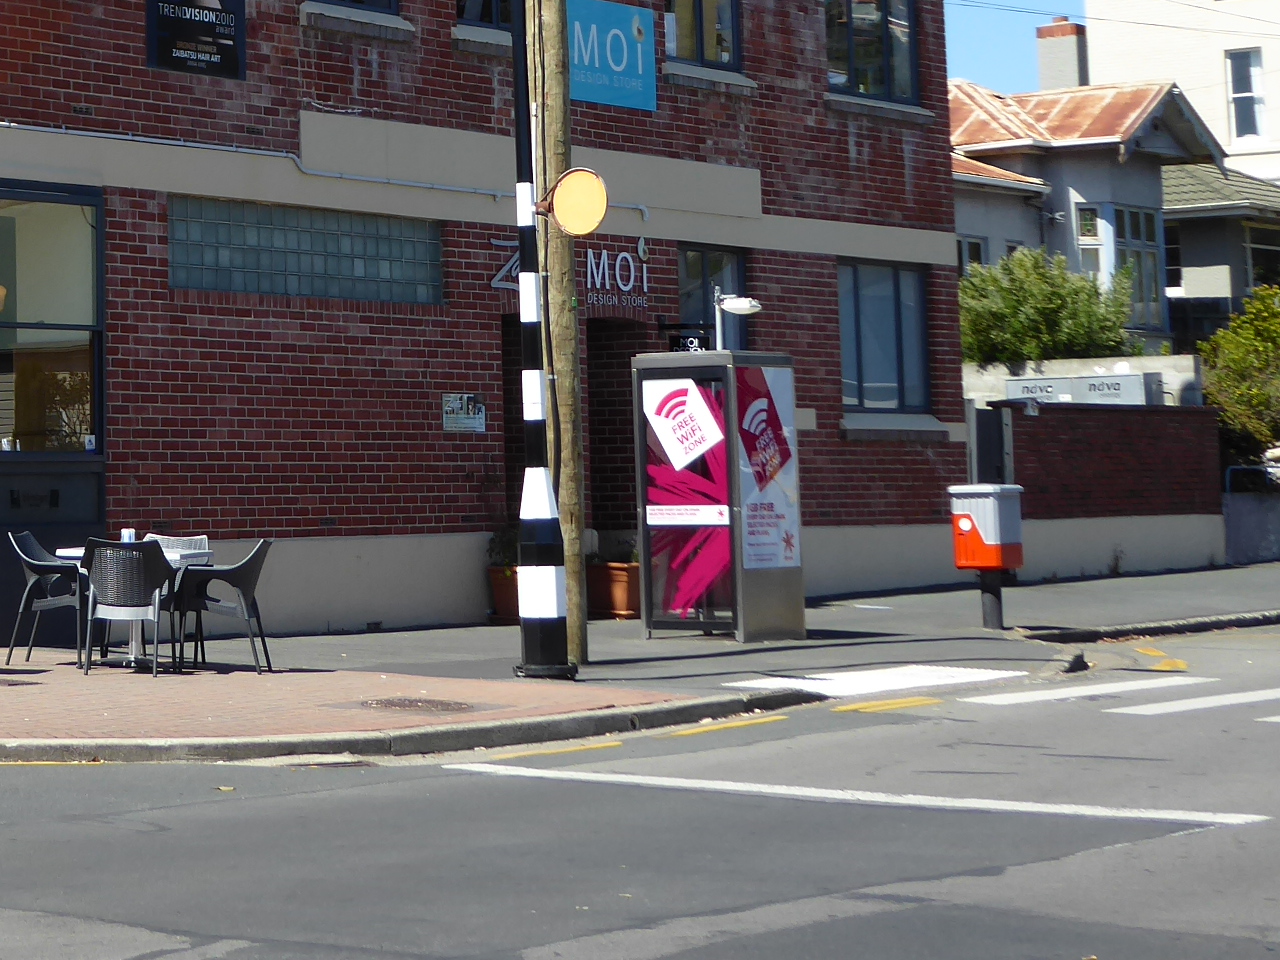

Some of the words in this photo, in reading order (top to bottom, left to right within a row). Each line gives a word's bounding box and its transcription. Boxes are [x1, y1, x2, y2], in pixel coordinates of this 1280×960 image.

[172, 48, 197, 60] ZAIBATSU
[198, 52, 211, 61] HAIR
[211, 55, 221, 63] ART
[574, 70, 609, 86] DESIGN
[613, 75, 643, 91] STORE
[587, 293, 618, 305] DESIGN
[621, 295, 649, 307] STORE
[679, 337, 699, 348] MOI
[671, 412, 697, 435] FREE
[683, 434, 708, 455] ZONE
[756, 426, 774, 451] FREE
